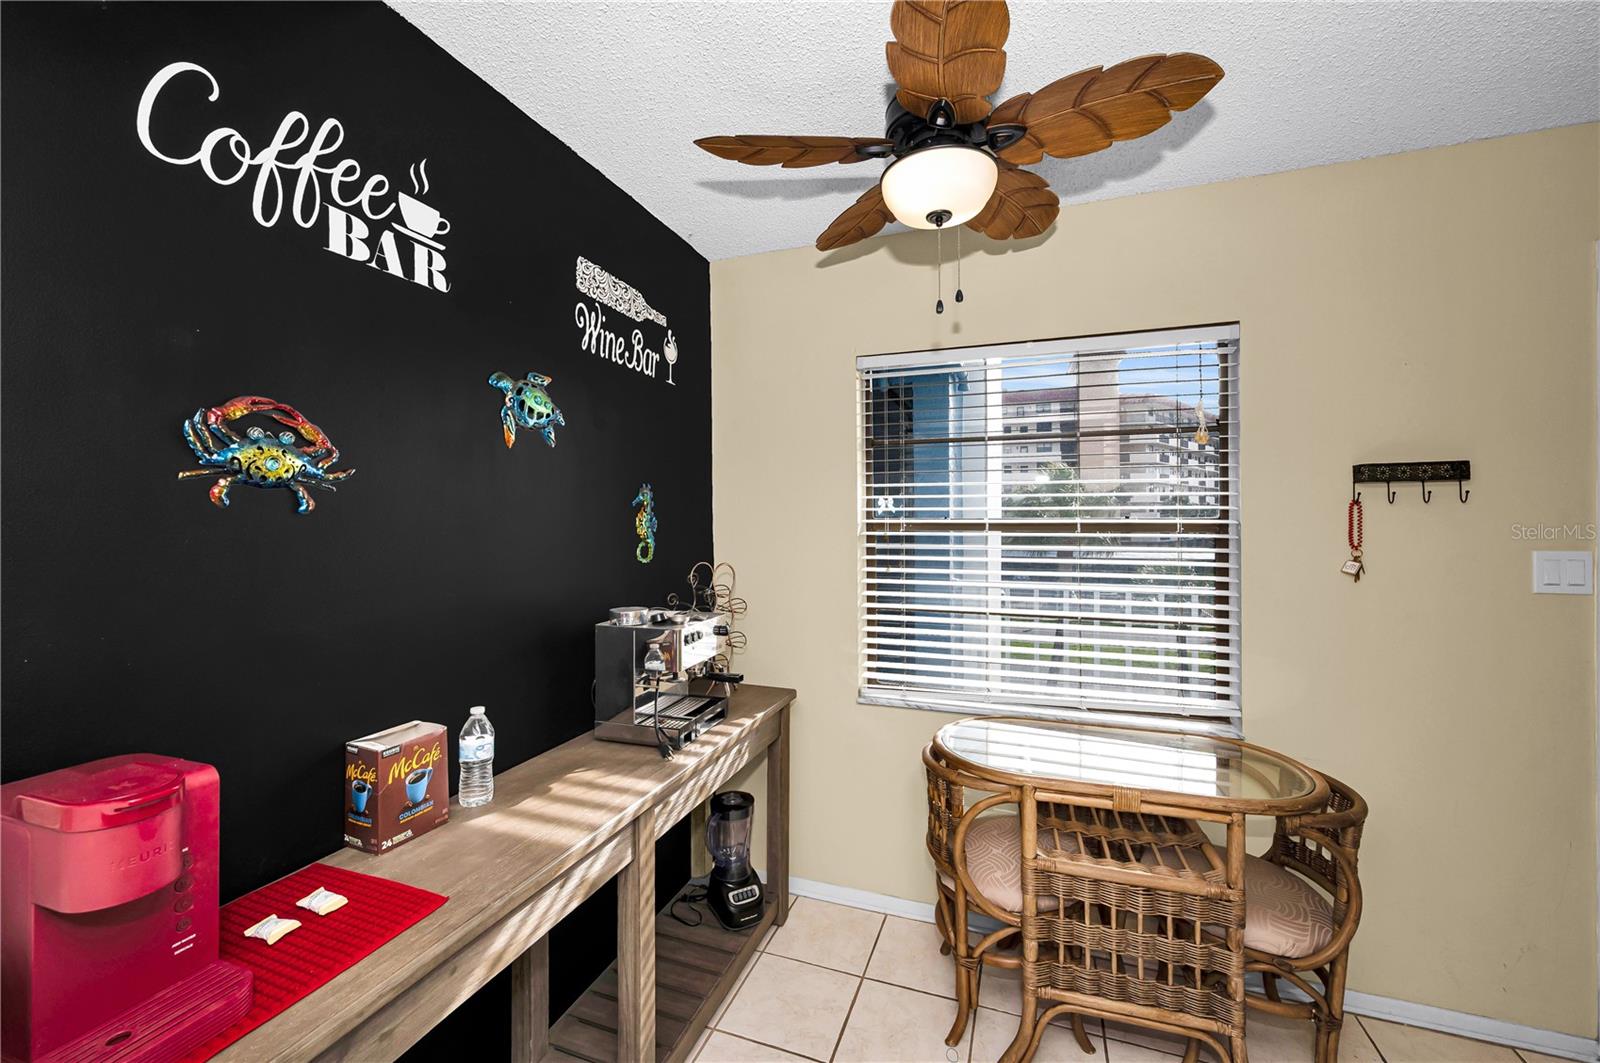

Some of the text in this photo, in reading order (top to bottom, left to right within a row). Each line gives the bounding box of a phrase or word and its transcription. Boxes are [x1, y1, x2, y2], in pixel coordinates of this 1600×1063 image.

[136, 61, 396, 229] Coffee
[322, 202, 451, 293] BAR
[575, 302, 660, 379] Wine Bar
[381, 838, 393, 850] 24
